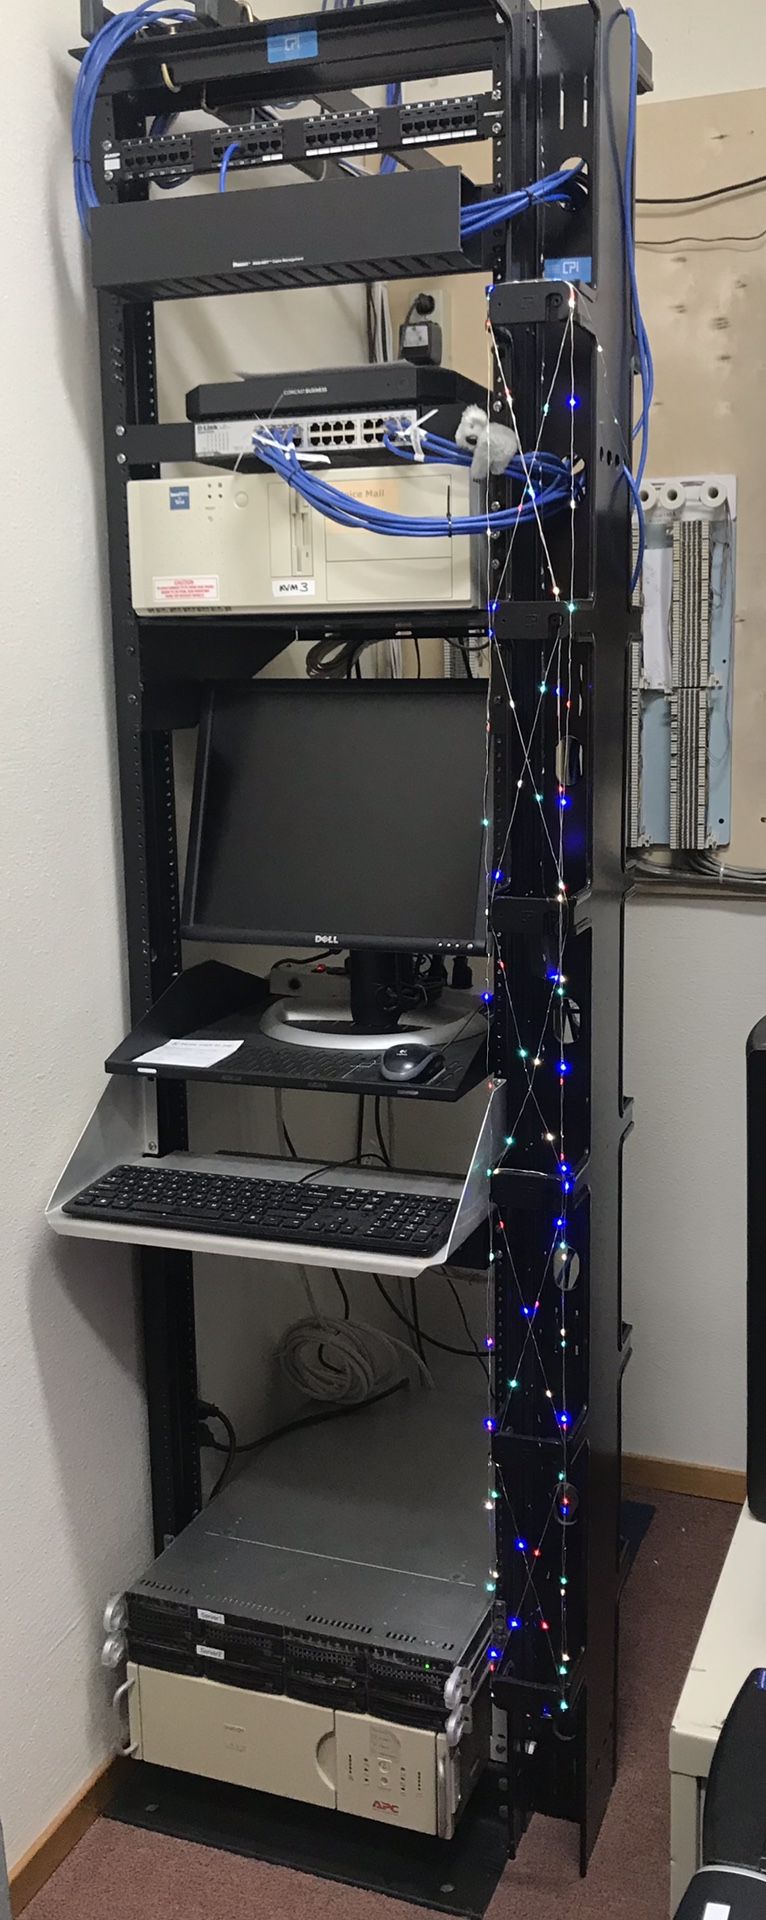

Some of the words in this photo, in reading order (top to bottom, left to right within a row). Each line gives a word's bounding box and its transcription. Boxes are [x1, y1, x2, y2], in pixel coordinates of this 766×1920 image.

[562, 261, 579, 274] CPI
[300, 582, 309, 592] 3
[314, 934, 339, 944] DELL
[372, 1800, 399, 1813] APC
